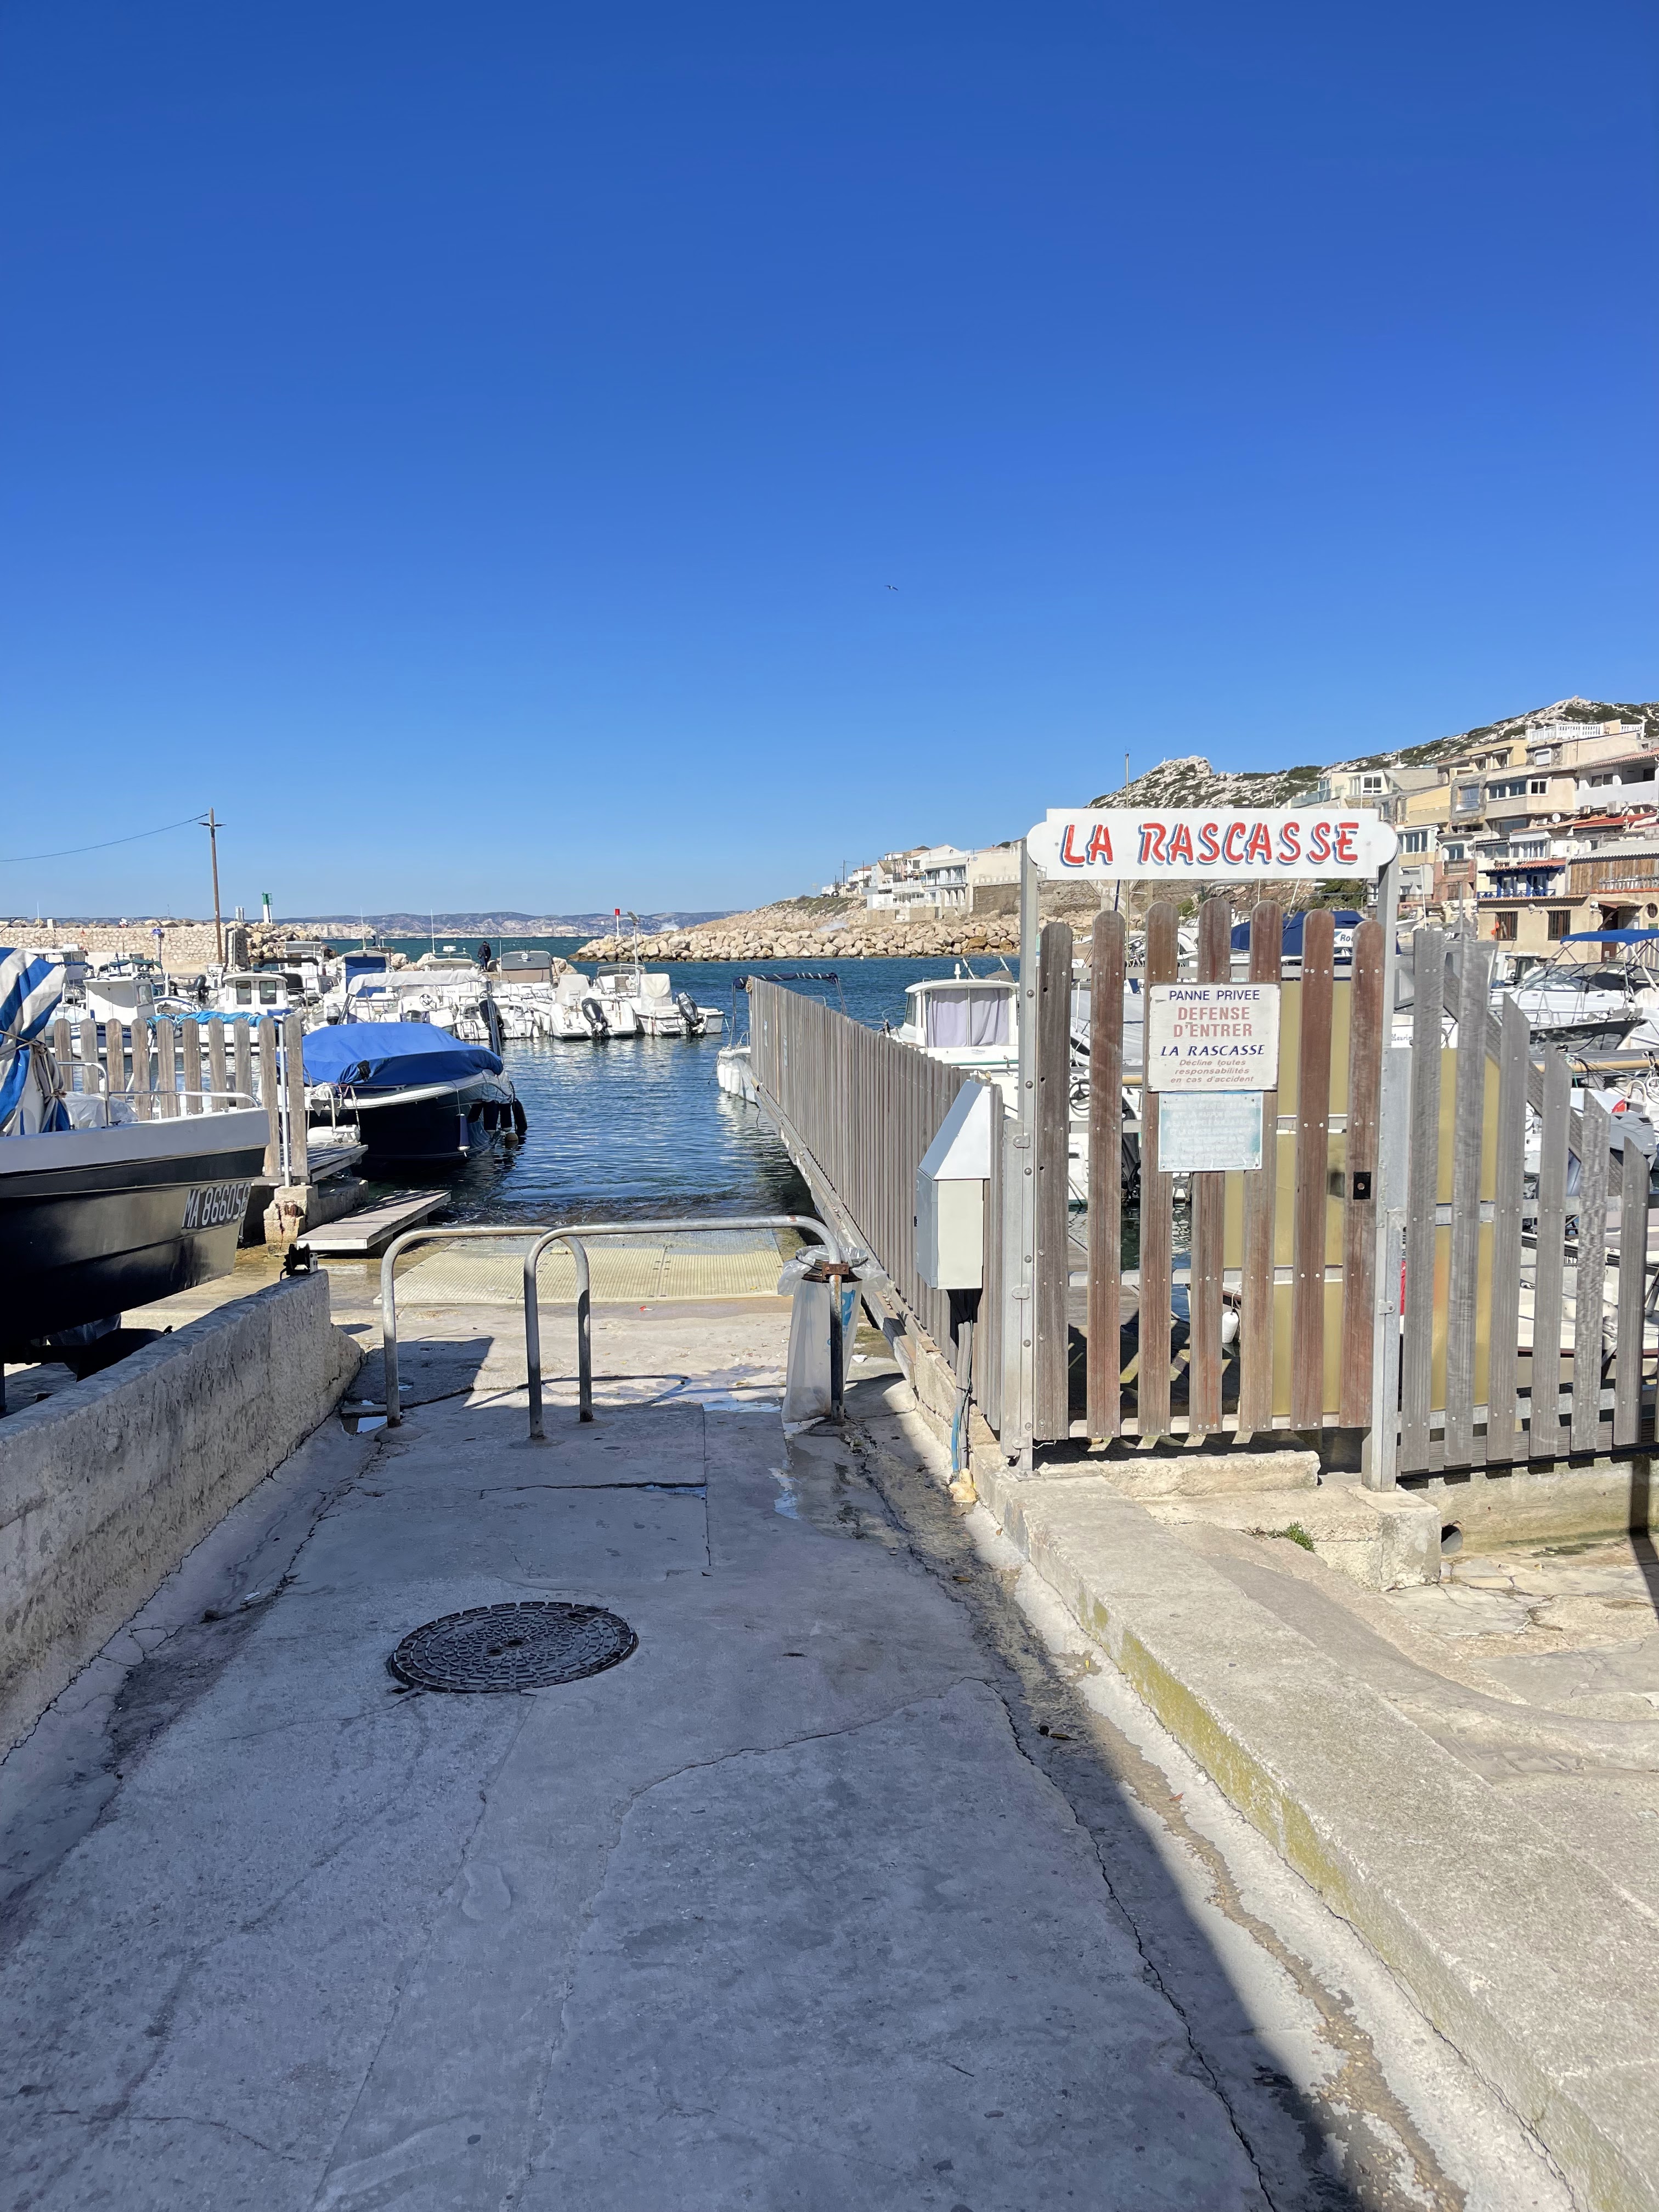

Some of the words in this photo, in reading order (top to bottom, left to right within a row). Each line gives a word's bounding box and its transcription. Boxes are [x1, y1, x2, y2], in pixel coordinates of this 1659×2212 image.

[1059, 824, 1114, 867] LA
[1138, 822, 1359, 866] RASCASSE
[1169, 990, 1210, 1001] PANNE
[1216, 990, 1260, 1001] PRIVEE
[1178, 1006, 1250, 1020] DEFENSE
[1173, 1023, 1252, 1037] D'ENTRER
[1160, 1046, 1179, 1056] LA
[1187, 1045, 1265, 1056] RASCASSE
[1175, 1067, 1250, 1075] responsabilités
[181, 1189, 201, 1228] MA
